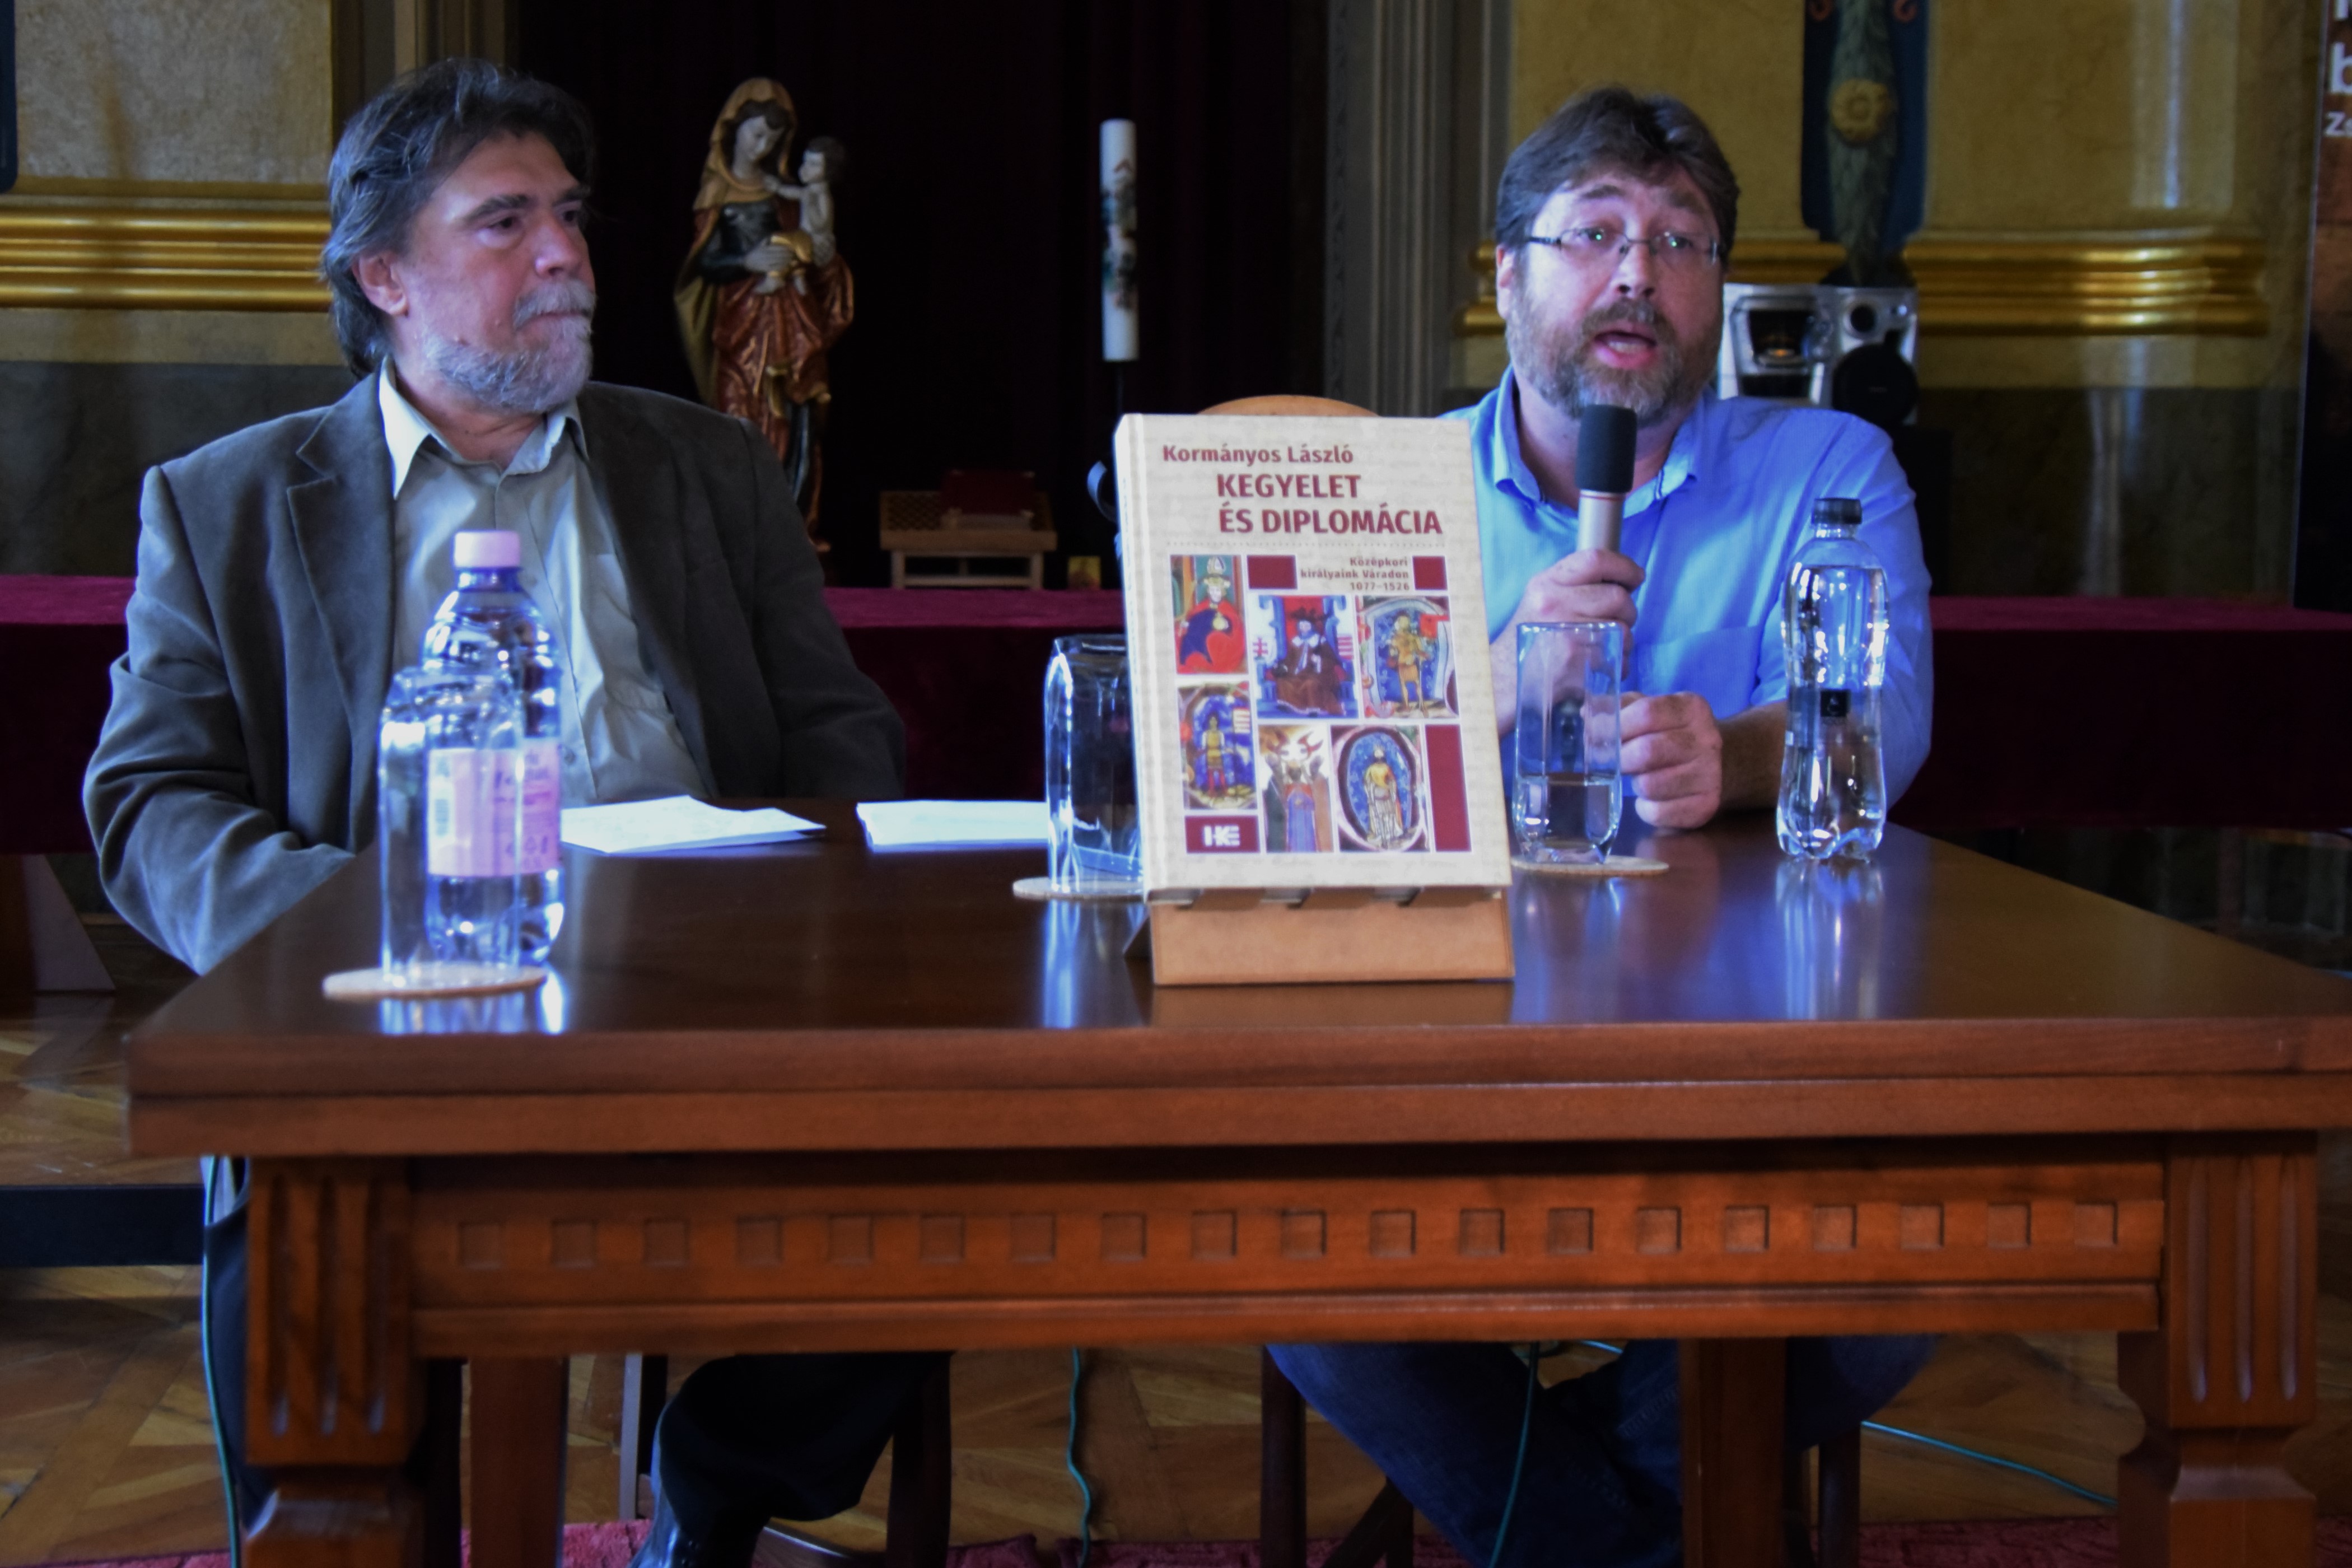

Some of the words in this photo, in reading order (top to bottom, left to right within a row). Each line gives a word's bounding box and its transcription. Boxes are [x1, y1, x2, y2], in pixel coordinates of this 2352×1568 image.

[1163, 443, 1282, 467] Kormányos
[1287, 444, 1354, 463] László
[1216, 474, 1361, 498] KEGYELET
[1219, 501, 1253, 533] ÉS
[1261, 502, 1443, 534] DIPLOMÁCIA
[1349, 556, 1408, 567] Középkori
[1300, 568, 1359, 580] királyaink
[1362, 570, 1409, 578] Váradon
